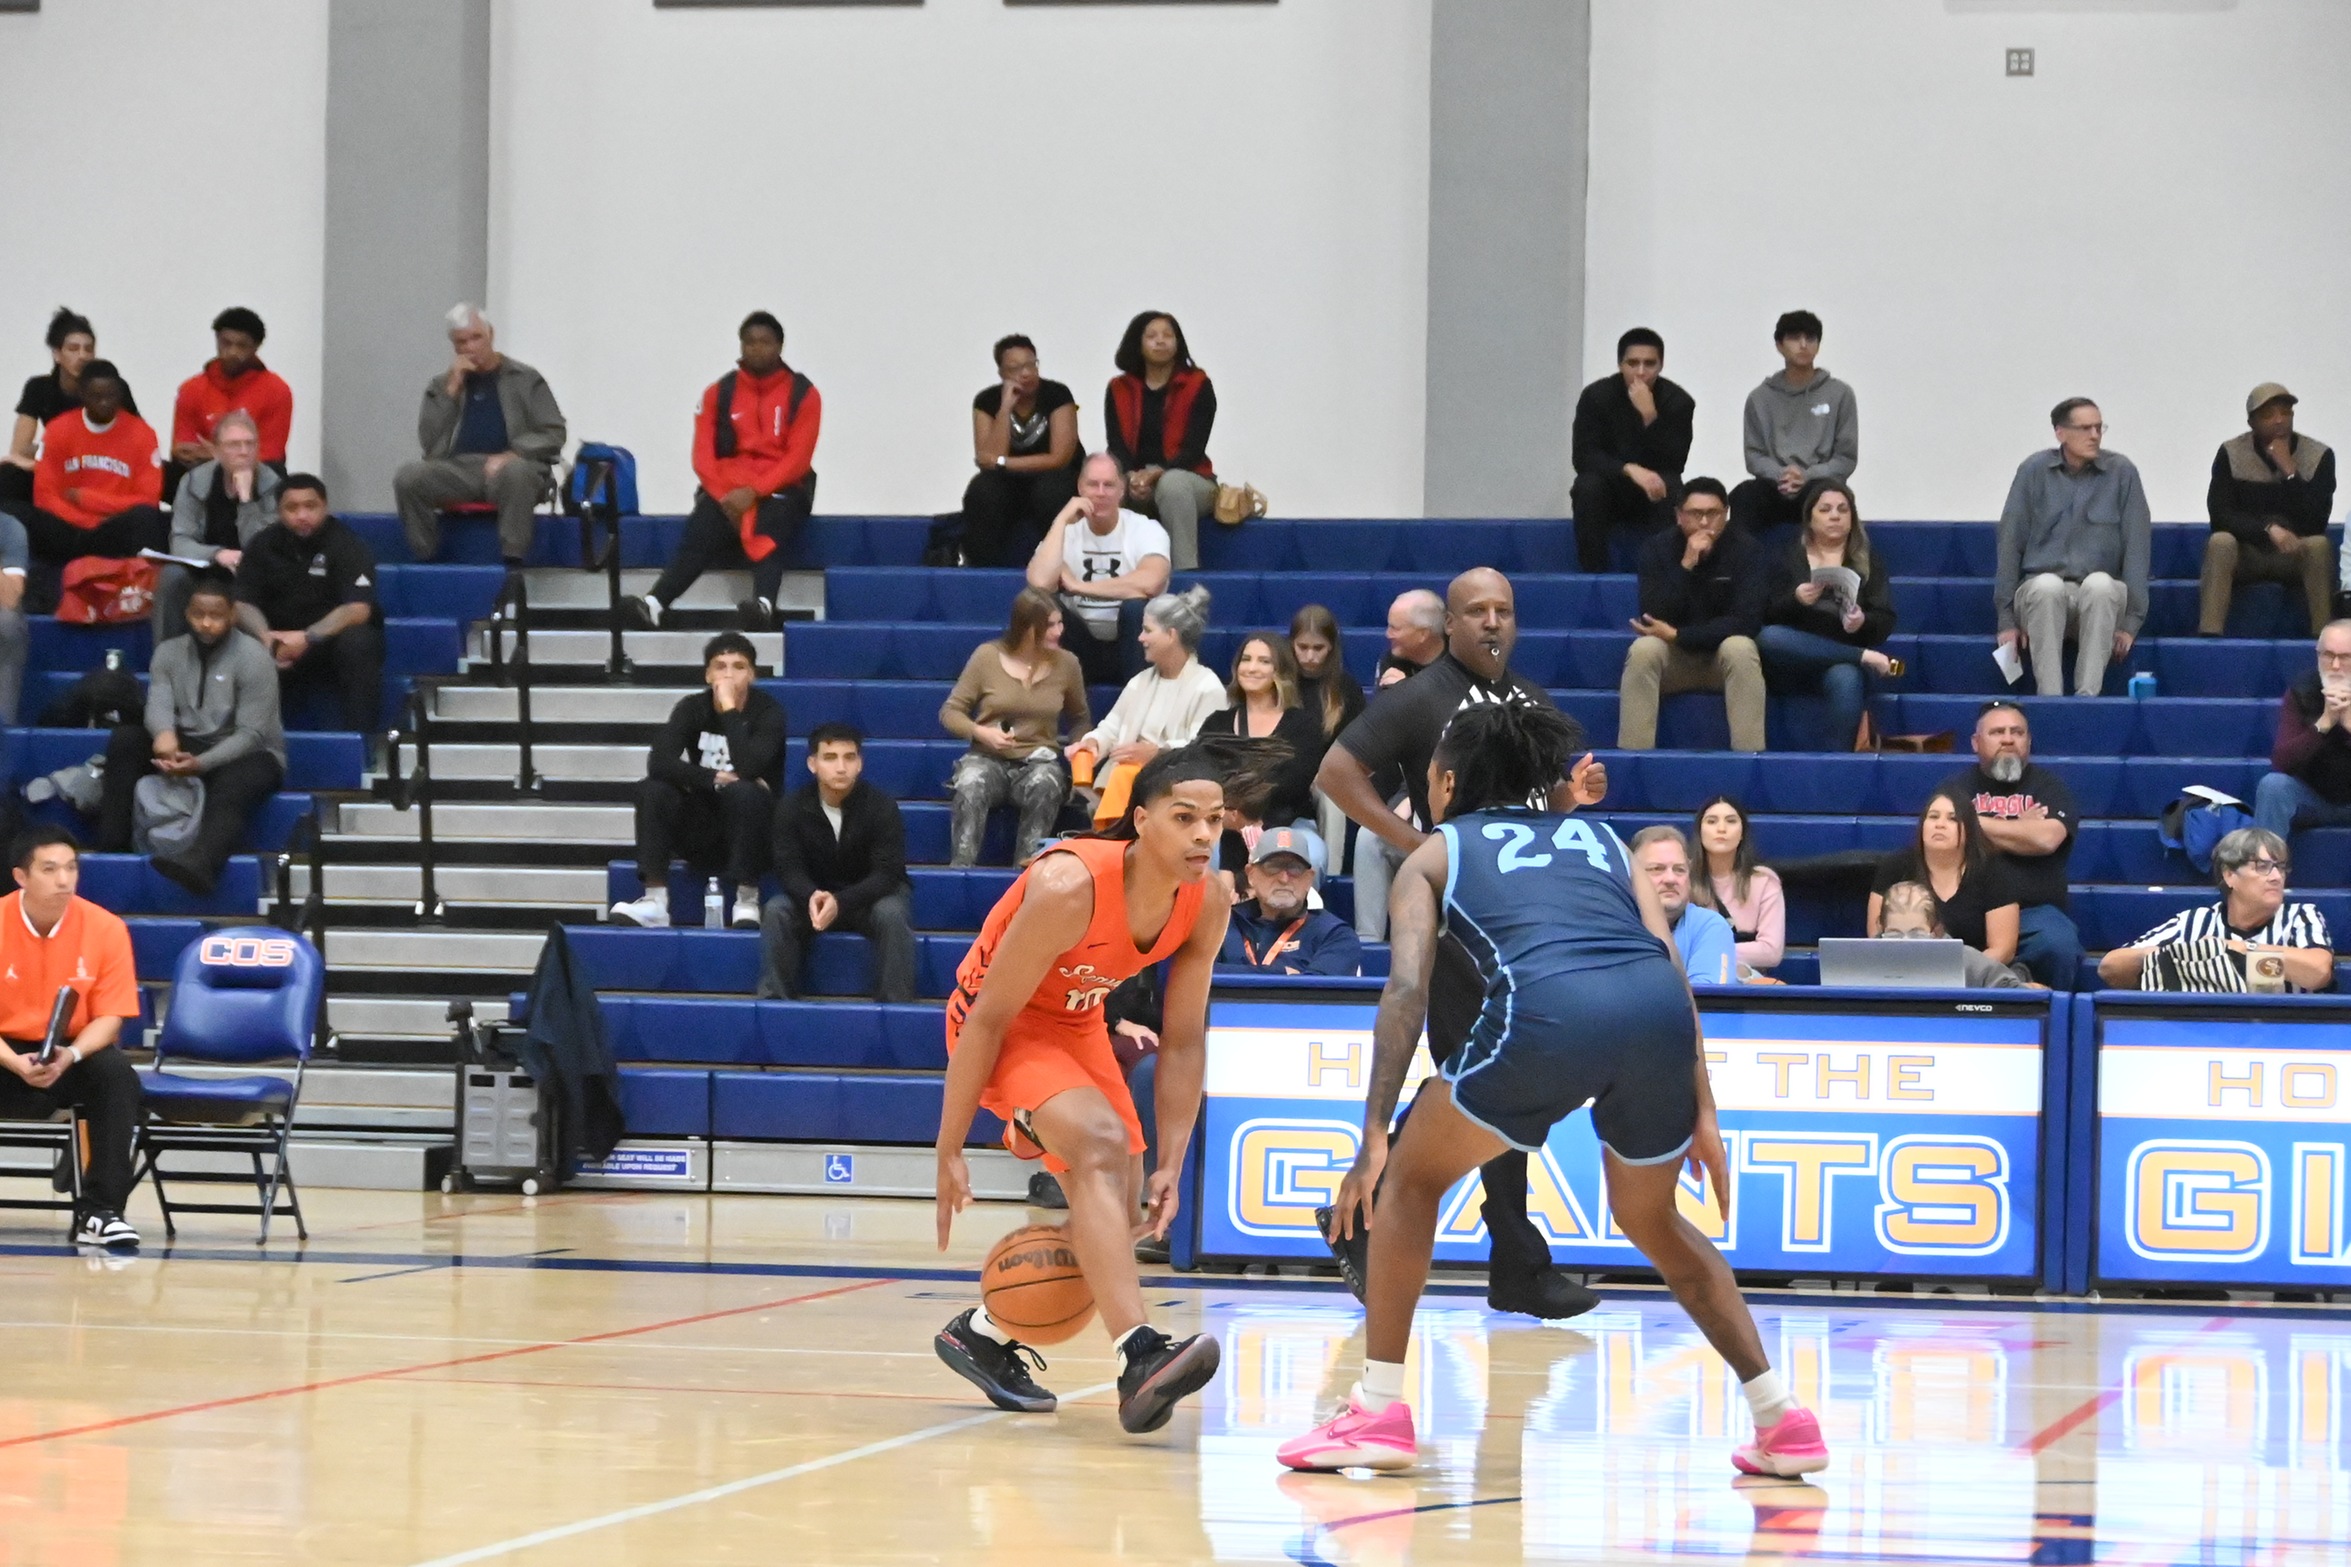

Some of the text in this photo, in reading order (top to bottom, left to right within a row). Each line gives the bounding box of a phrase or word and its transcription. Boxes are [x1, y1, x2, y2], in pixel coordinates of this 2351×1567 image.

[1481, 818, 1611, 874] 24
[200, 937, 295, 967] COS
[1757, 1052, 1935, 1101] THE
[621, 1163, 642, 1171] UPON
[643, 1163, 678, 1171] REQUEST
[636, 1154, 653, 1162] WILL
[1228, 1117, 2010, 1257] GANTS
[2125, 1138, 2351, 1266] GI
